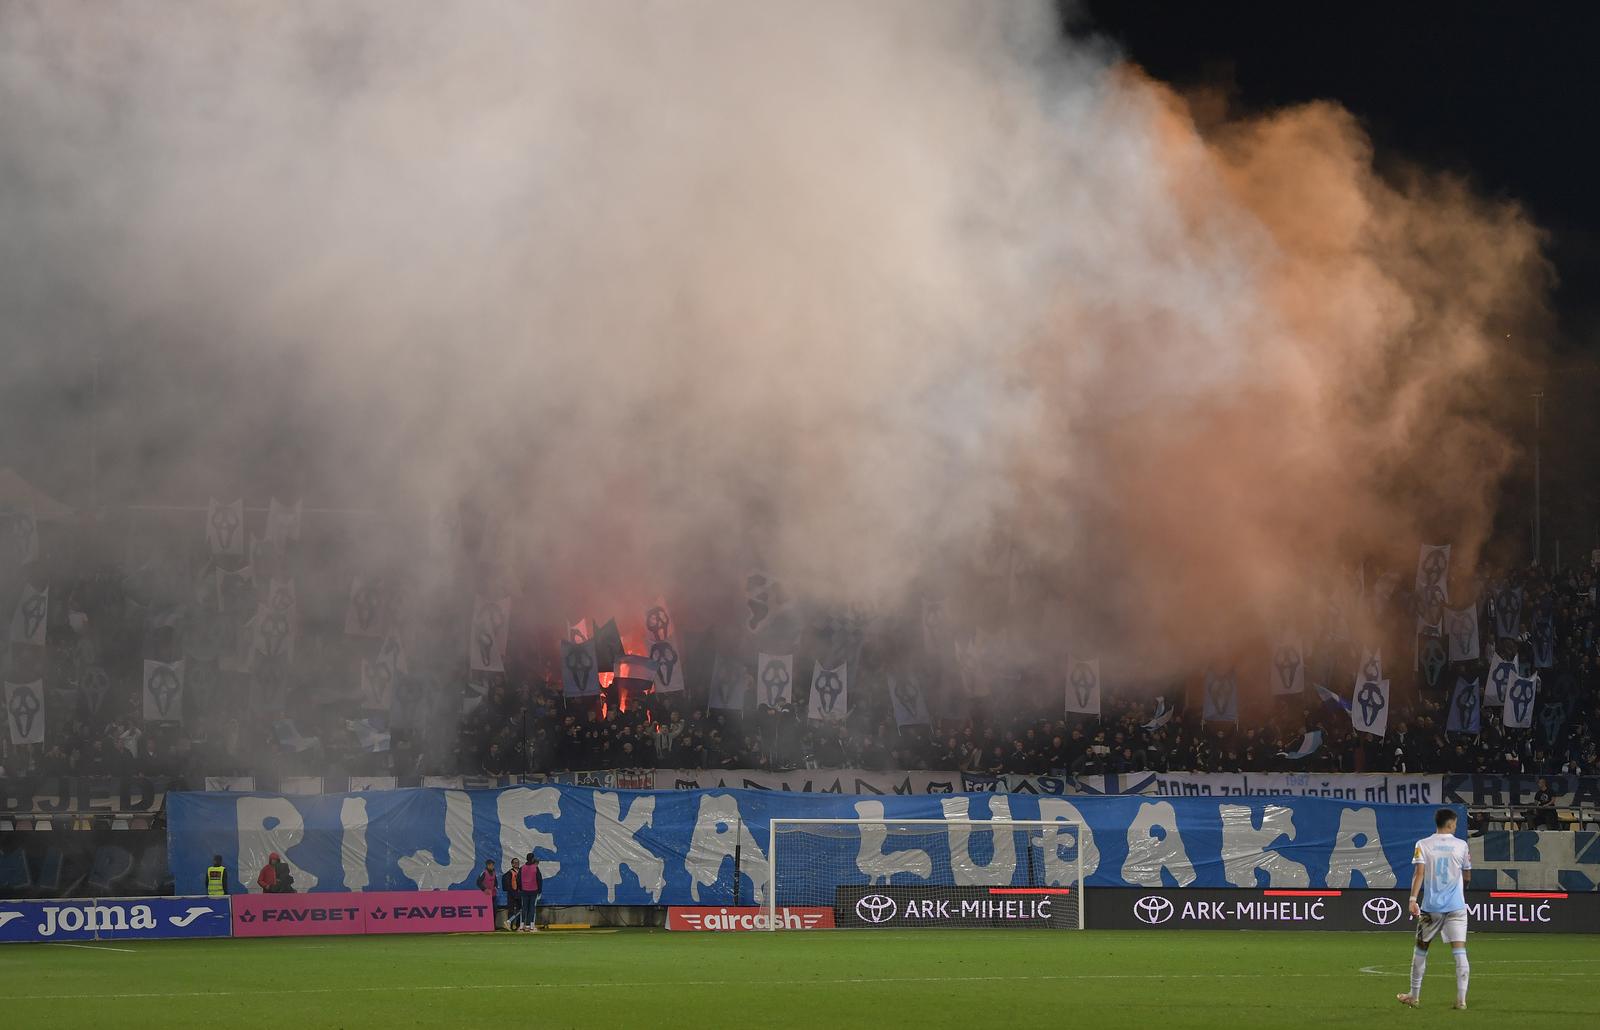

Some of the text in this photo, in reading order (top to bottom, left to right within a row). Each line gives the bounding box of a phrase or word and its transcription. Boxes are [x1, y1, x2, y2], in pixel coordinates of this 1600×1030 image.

[236, 786, 770, 904] RIJEKA
[853, 795, 1398, 890] LUĐAKA
[262, 907, 359, 922] FAVBET
[393, 905, 488, 919] FAVBET
[704, 907, 801, 930] aircash
[904, 896, 1052, 919] ARK-MIHELIĆ
[1181, 897, 1325, 920] ARK-MIHELIĆ
[1409, 900, 1551, 922] MIHELIĆ
